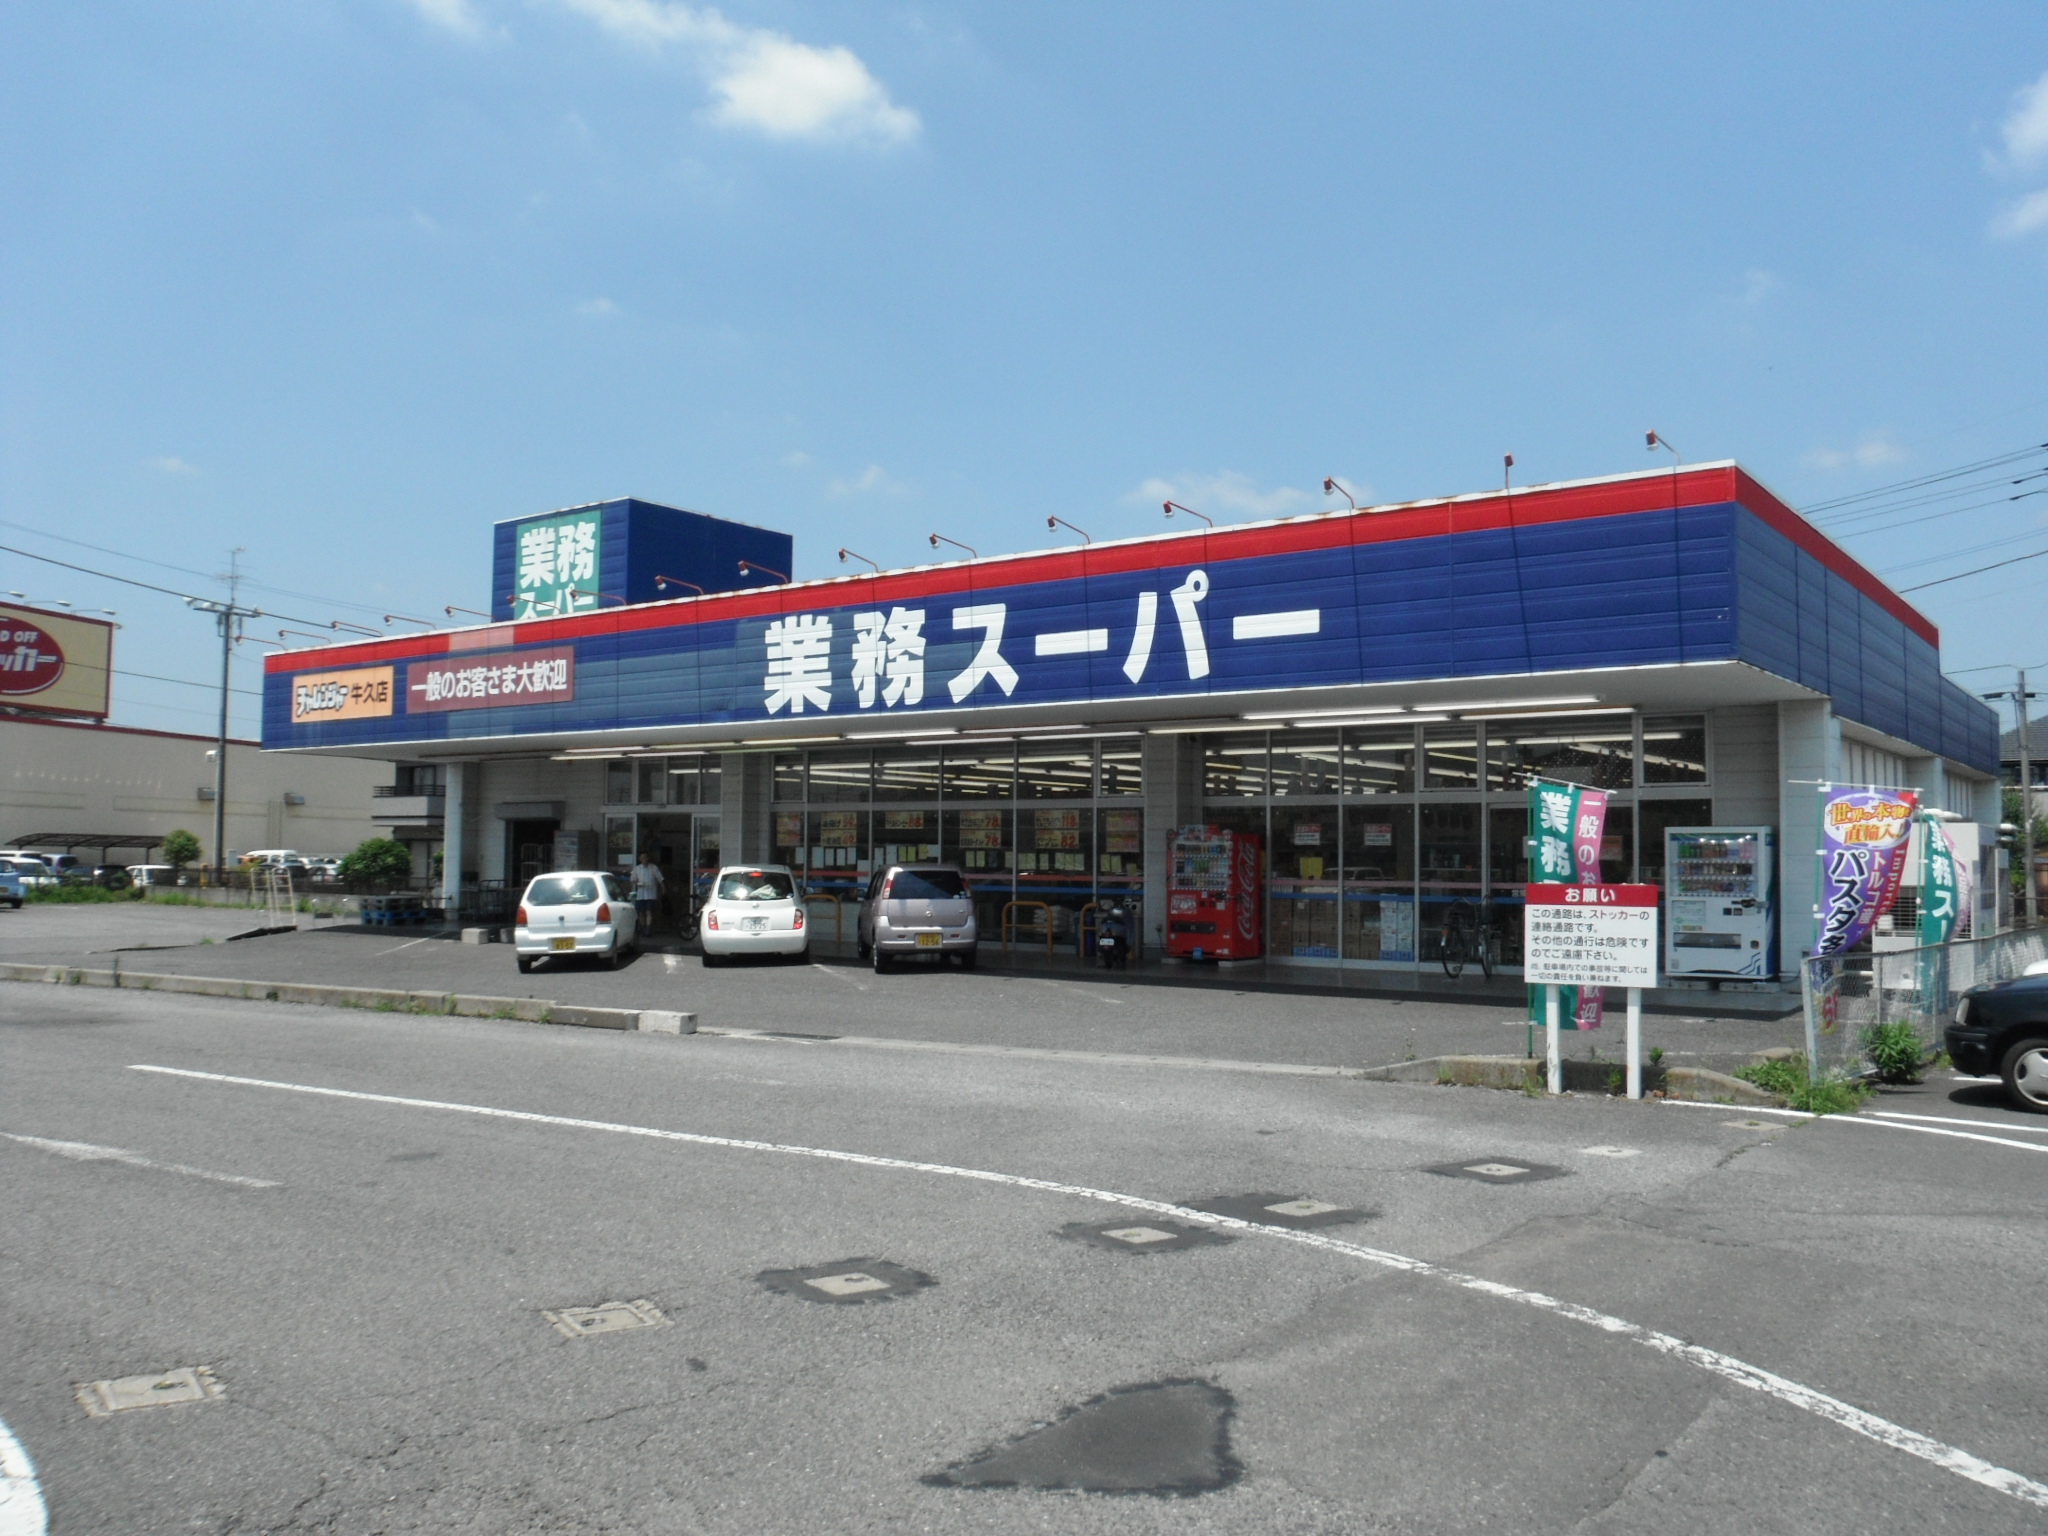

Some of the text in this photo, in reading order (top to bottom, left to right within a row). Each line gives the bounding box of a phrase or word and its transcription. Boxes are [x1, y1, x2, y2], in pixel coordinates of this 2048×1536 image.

[520, 522, 596, 589] 業務
[14, 631, 38, 643] OFF
[764, 569, 1320, 715] 業務スーパー
[411, 659, 568, 701] 一般のお客さま大歓迎
[296, 680, 389, 718] チャレンジャー 牛久店
[1540, 792, 1572, 884] 業務
[1564, 888, 1616, 903] お願い
[1532, 909, 1650, 921] この通路は、ストッカーの
[1531, 922, 1598, 933] 連絡通路です。
[1531, 936, 1649, 948] その他の通行は危険です
[1531, 949, 1618, 960] のでご遠慮下さい。
